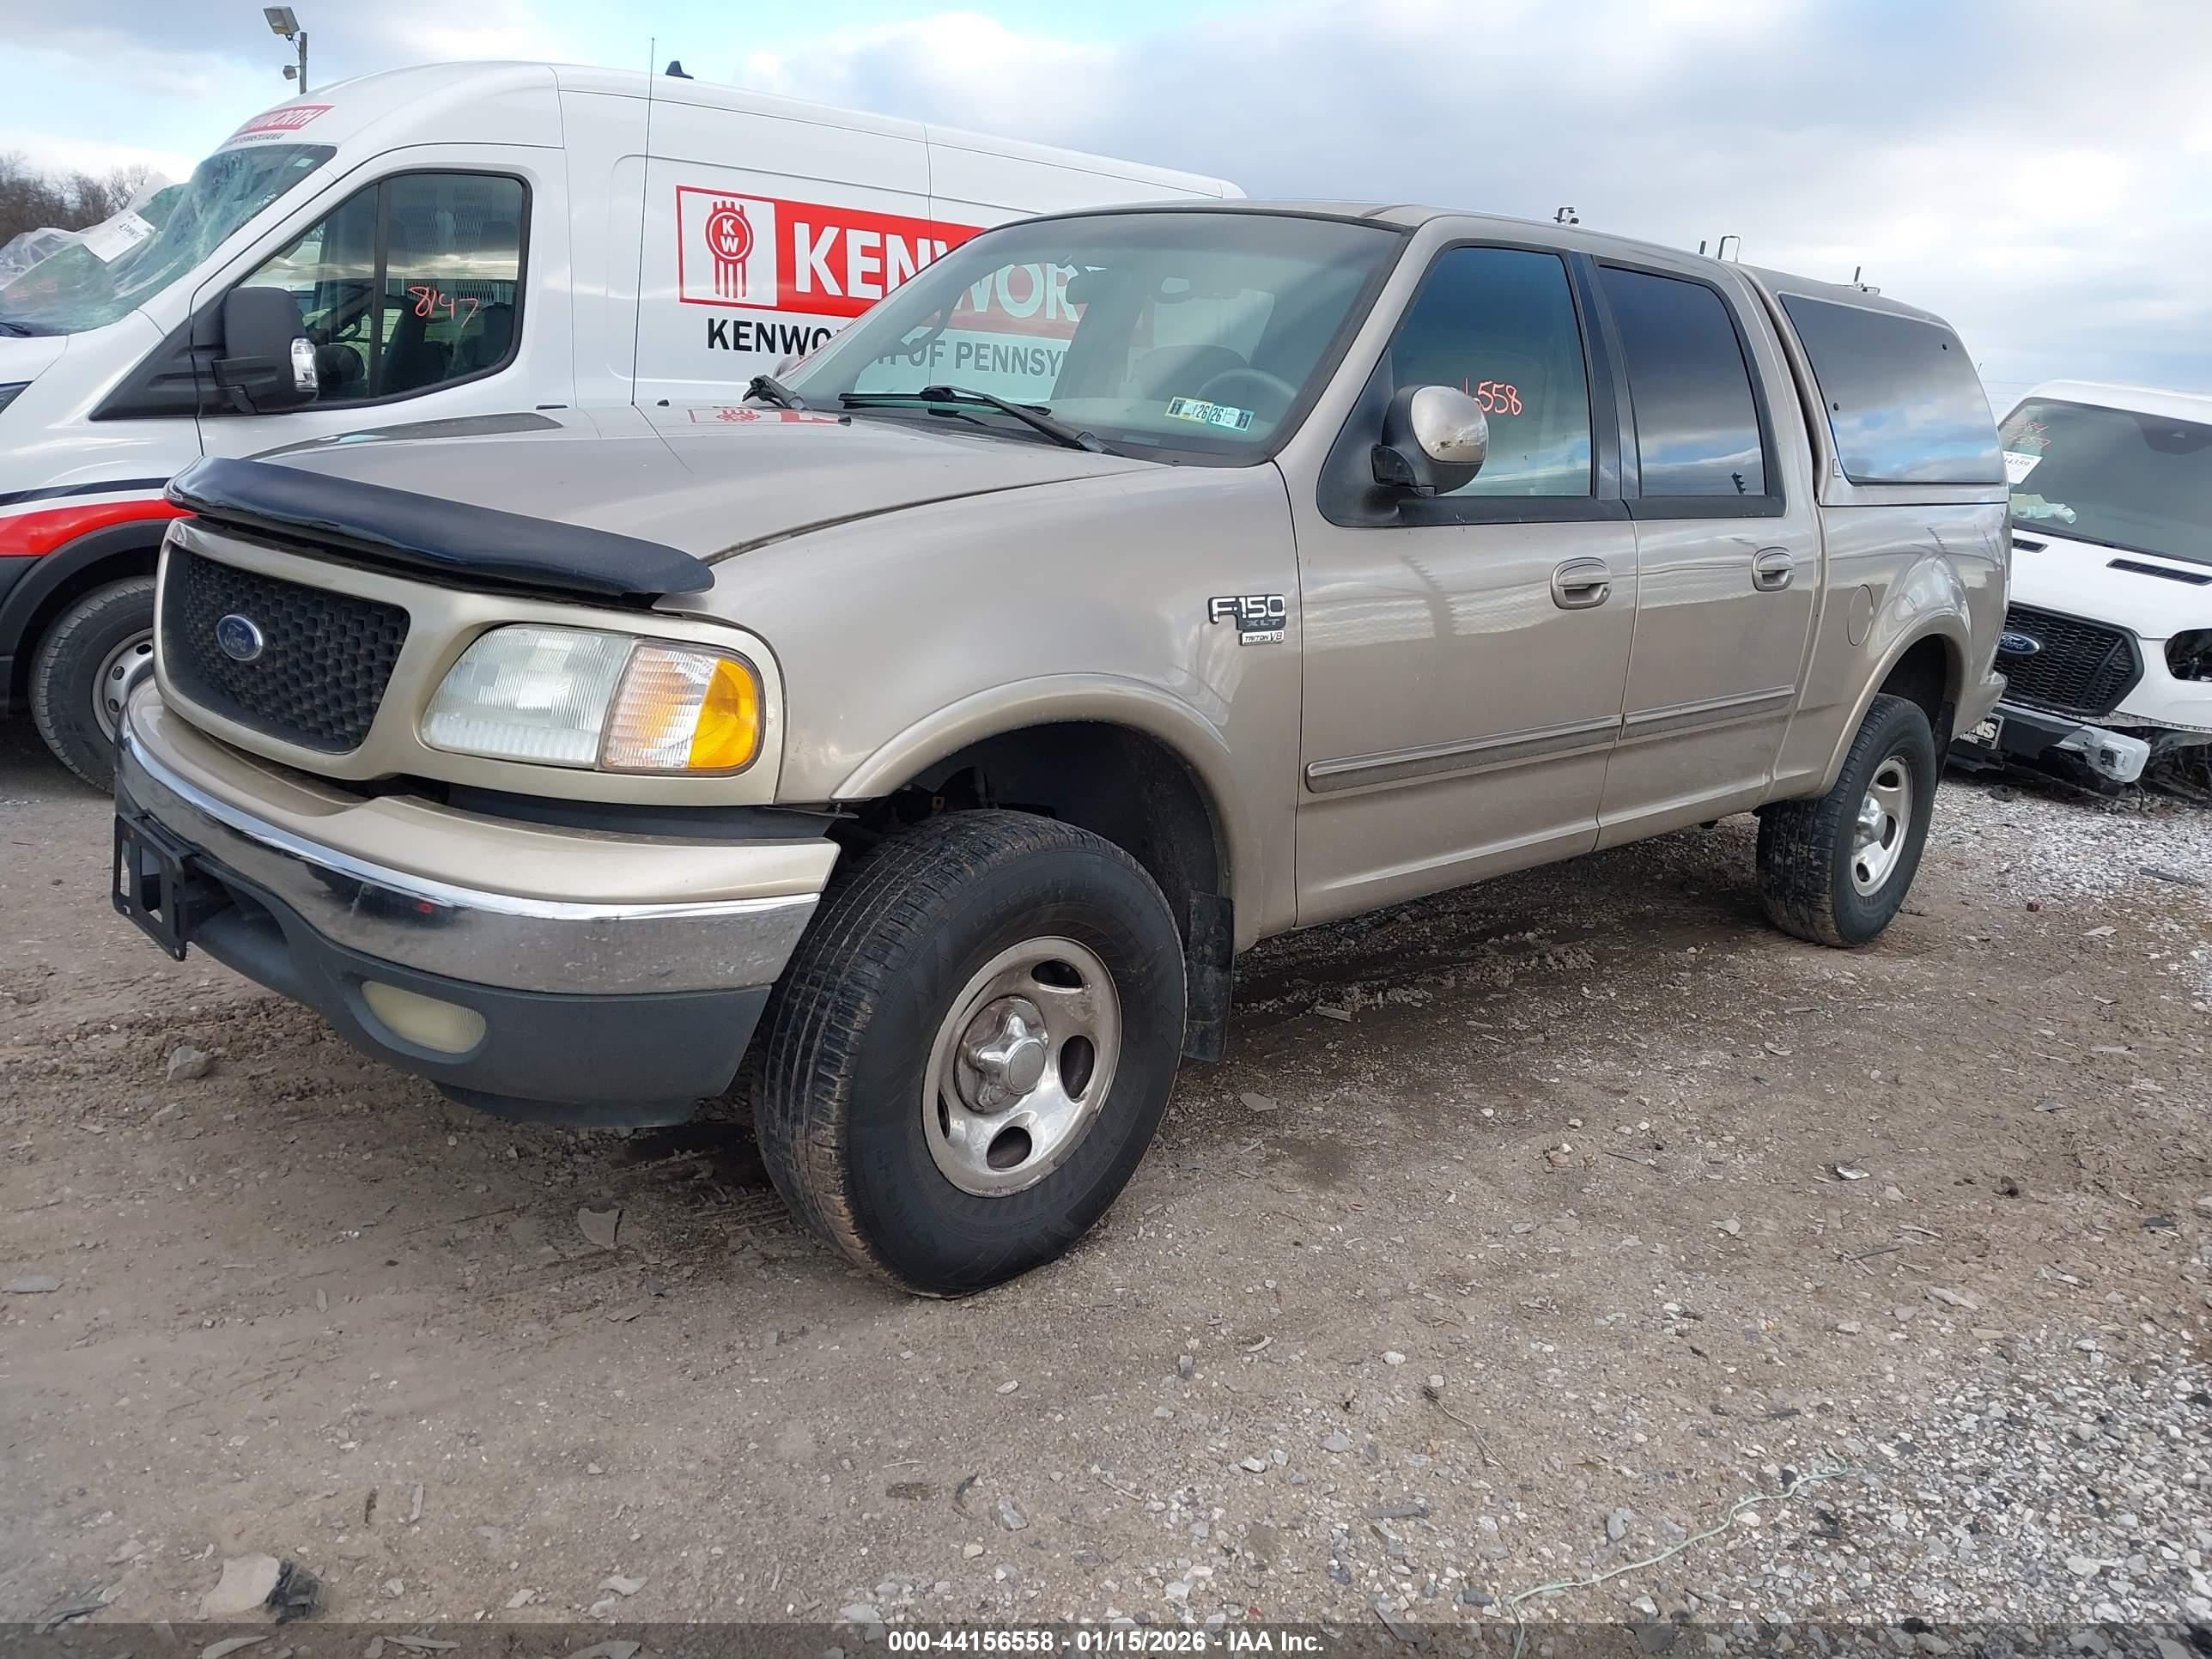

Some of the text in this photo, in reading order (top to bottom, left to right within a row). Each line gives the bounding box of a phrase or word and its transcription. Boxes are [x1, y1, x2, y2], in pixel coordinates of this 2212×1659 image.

[908, 337, 946, 368] OF
[955, 341, 1063, 377] PENNSY
[1196, 404, 1210, 420] 26
[1209, 407, 1224, 422] 26
[1246, 618, 1280, 627] XLT
[1270, 631, 1283, 642] V8
